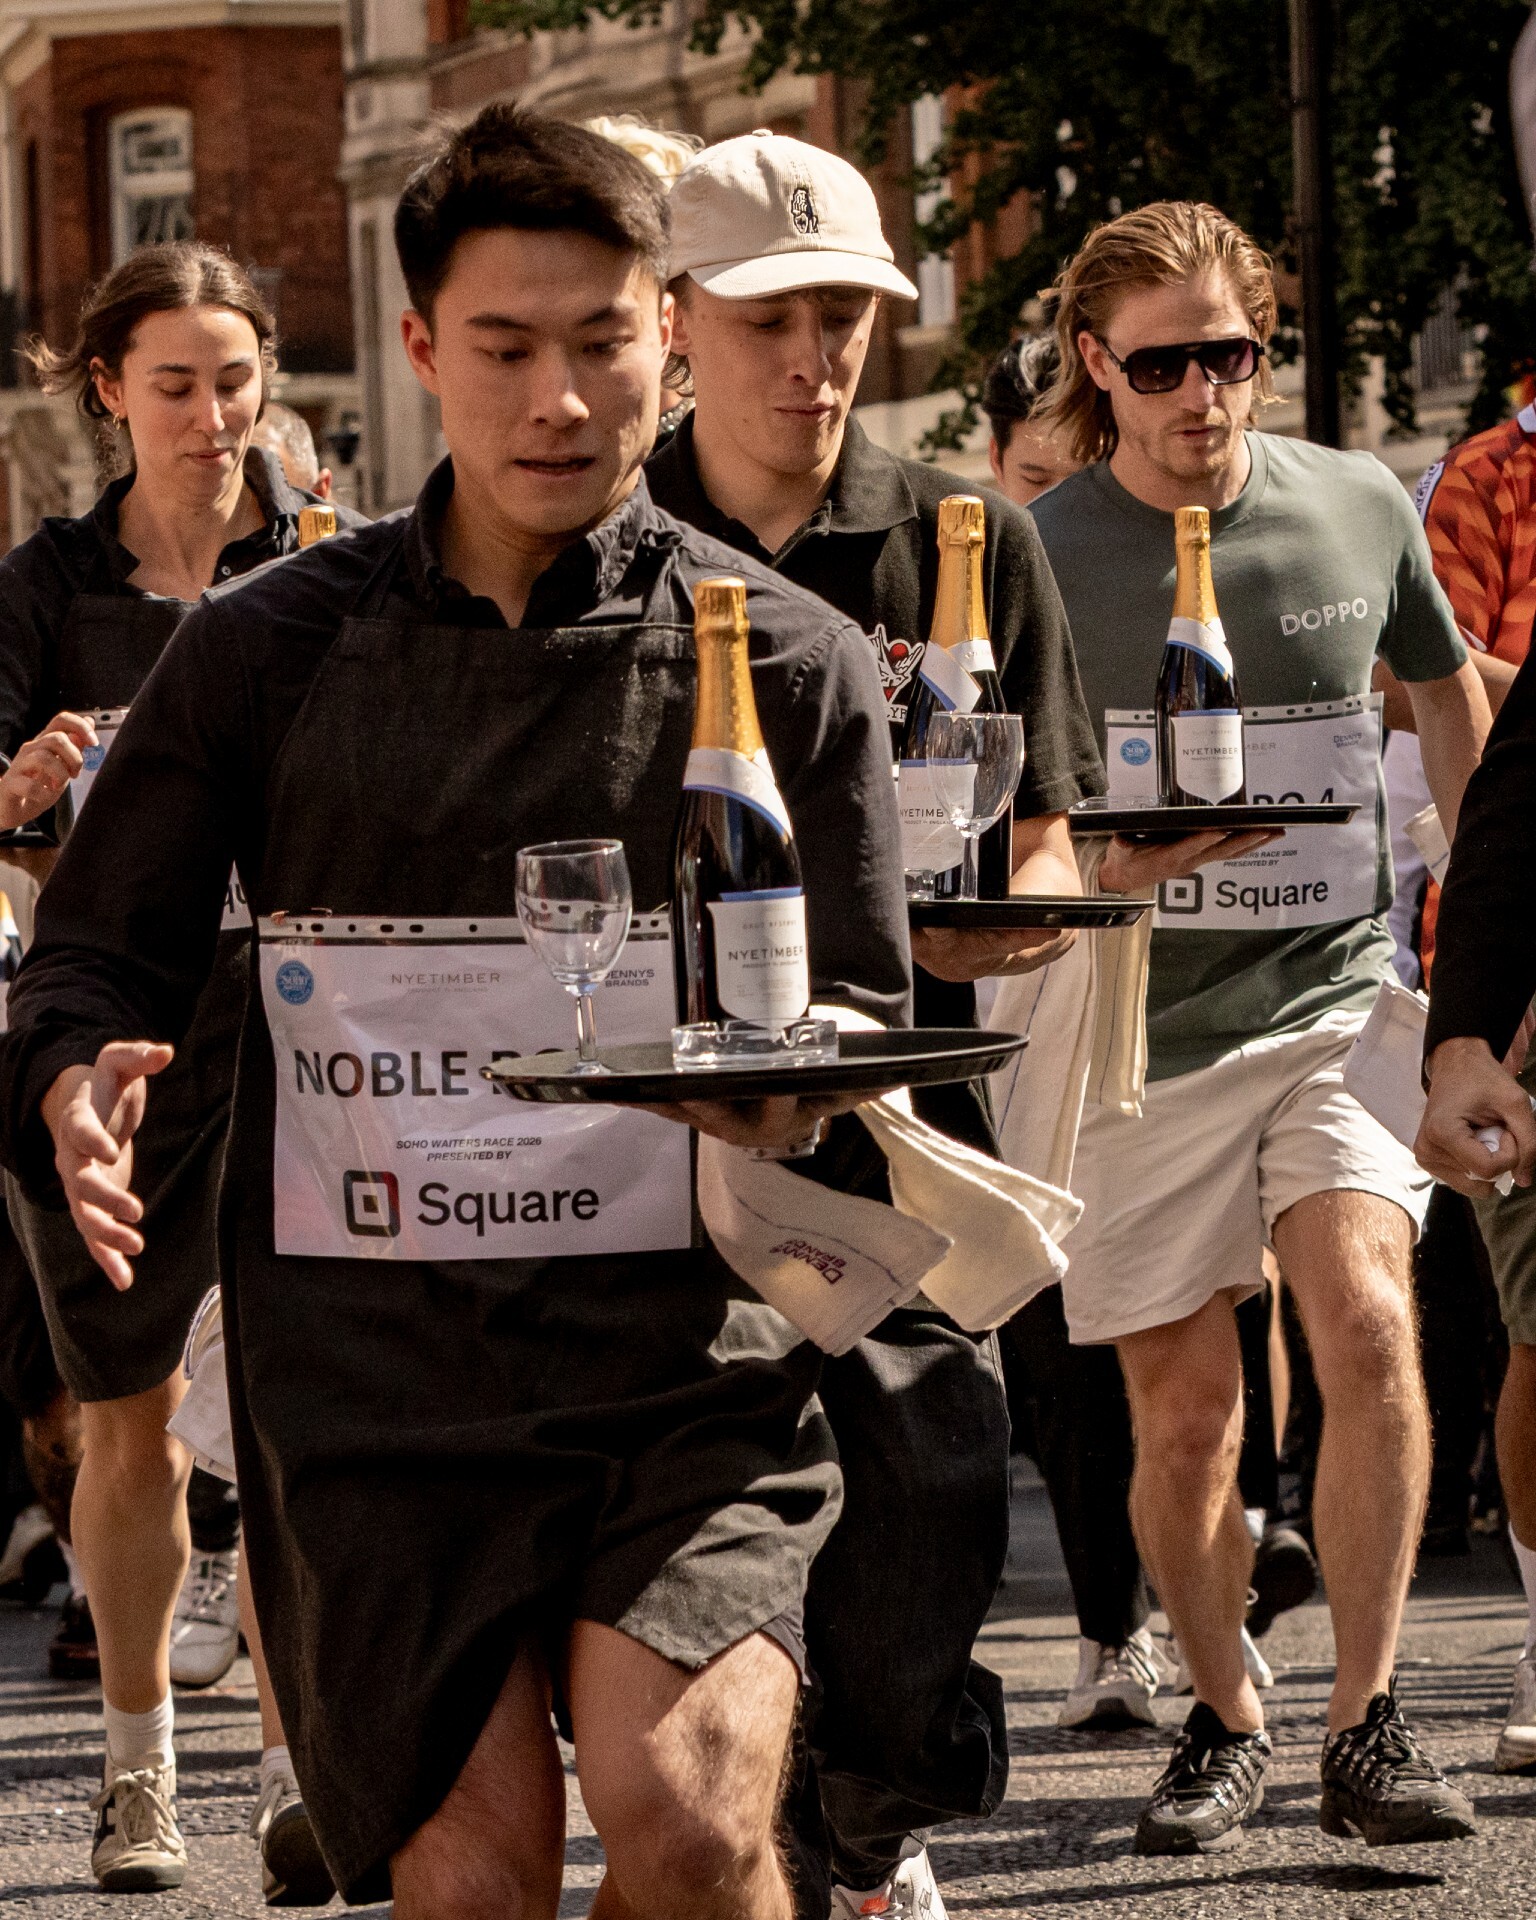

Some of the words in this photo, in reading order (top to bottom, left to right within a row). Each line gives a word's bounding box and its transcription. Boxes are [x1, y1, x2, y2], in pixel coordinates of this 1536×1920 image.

[1280, 597, 1368, 636] DOPPO
[1260, 850, 1280, 858] RACE
[1223, 860, 1267, 868] PRESENTED
[1268, 859, 1279, 867] BY
[1215, 880, 1328, 915] Square
[391, 972, 500, 984] NYETIMBER
[604, 979, 649, 988] BRANDS
[294, 1050, 470, 1098] NOBLE
[396, 1140, 428, 1149] SOHO
[431, 1138, 481, 1149] WAITERS
[483, 1137, 514, 1147] RACE
[516, 1136, 542, 1146] 2026
[427, 1151, 495, 1161] PRESENTED
[496, 1151, 512, 1160] BY
[417, 1182, 600, 1237] Square
